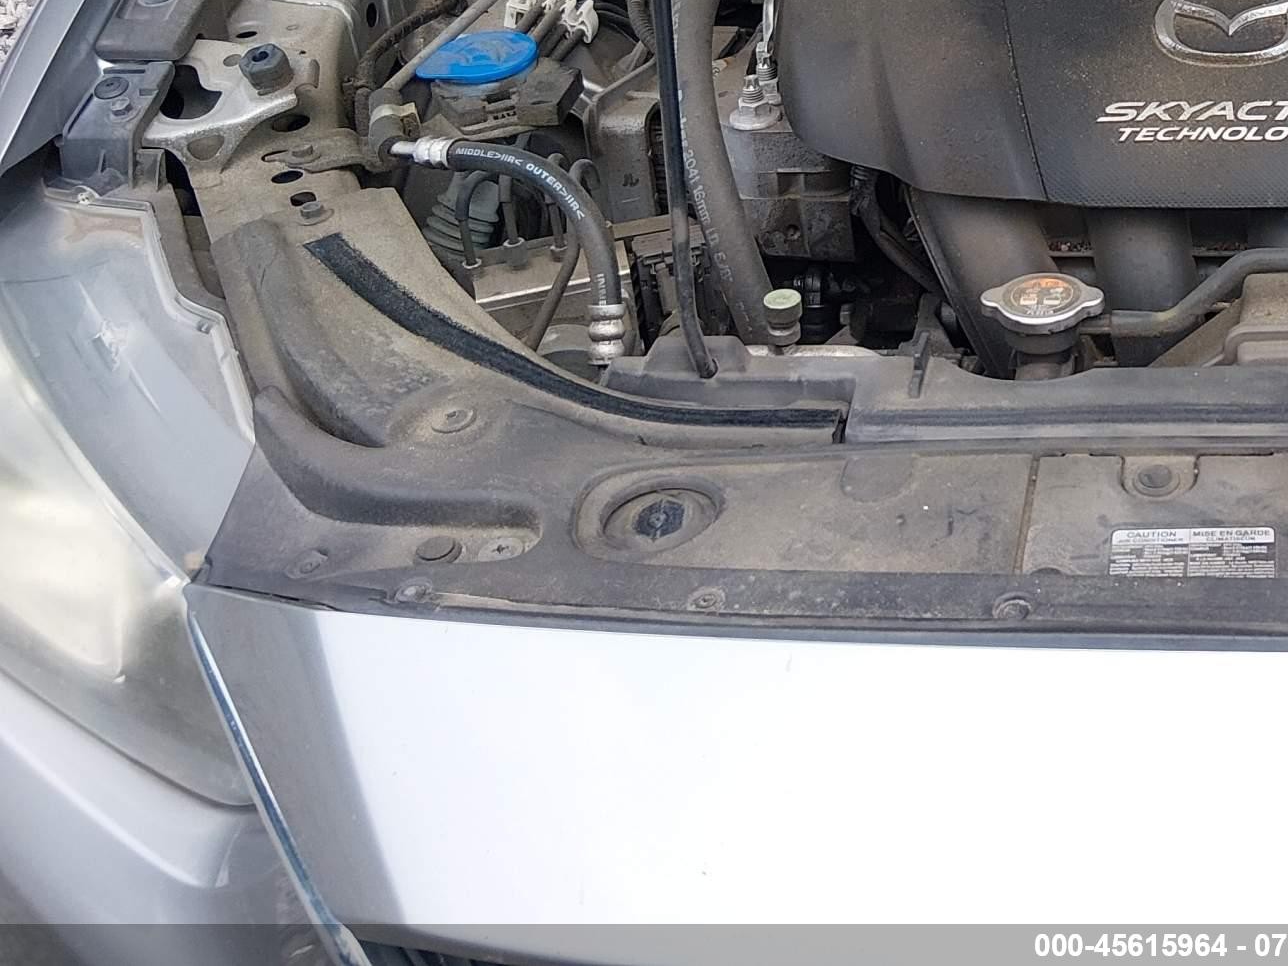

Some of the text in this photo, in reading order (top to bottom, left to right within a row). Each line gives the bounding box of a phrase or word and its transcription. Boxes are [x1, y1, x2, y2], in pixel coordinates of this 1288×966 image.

[1126, 530, 1177, 539] CAUTION
[1192, 530, 1217, 538] MISE
[1236, 529, 1270, 537] GARDE
